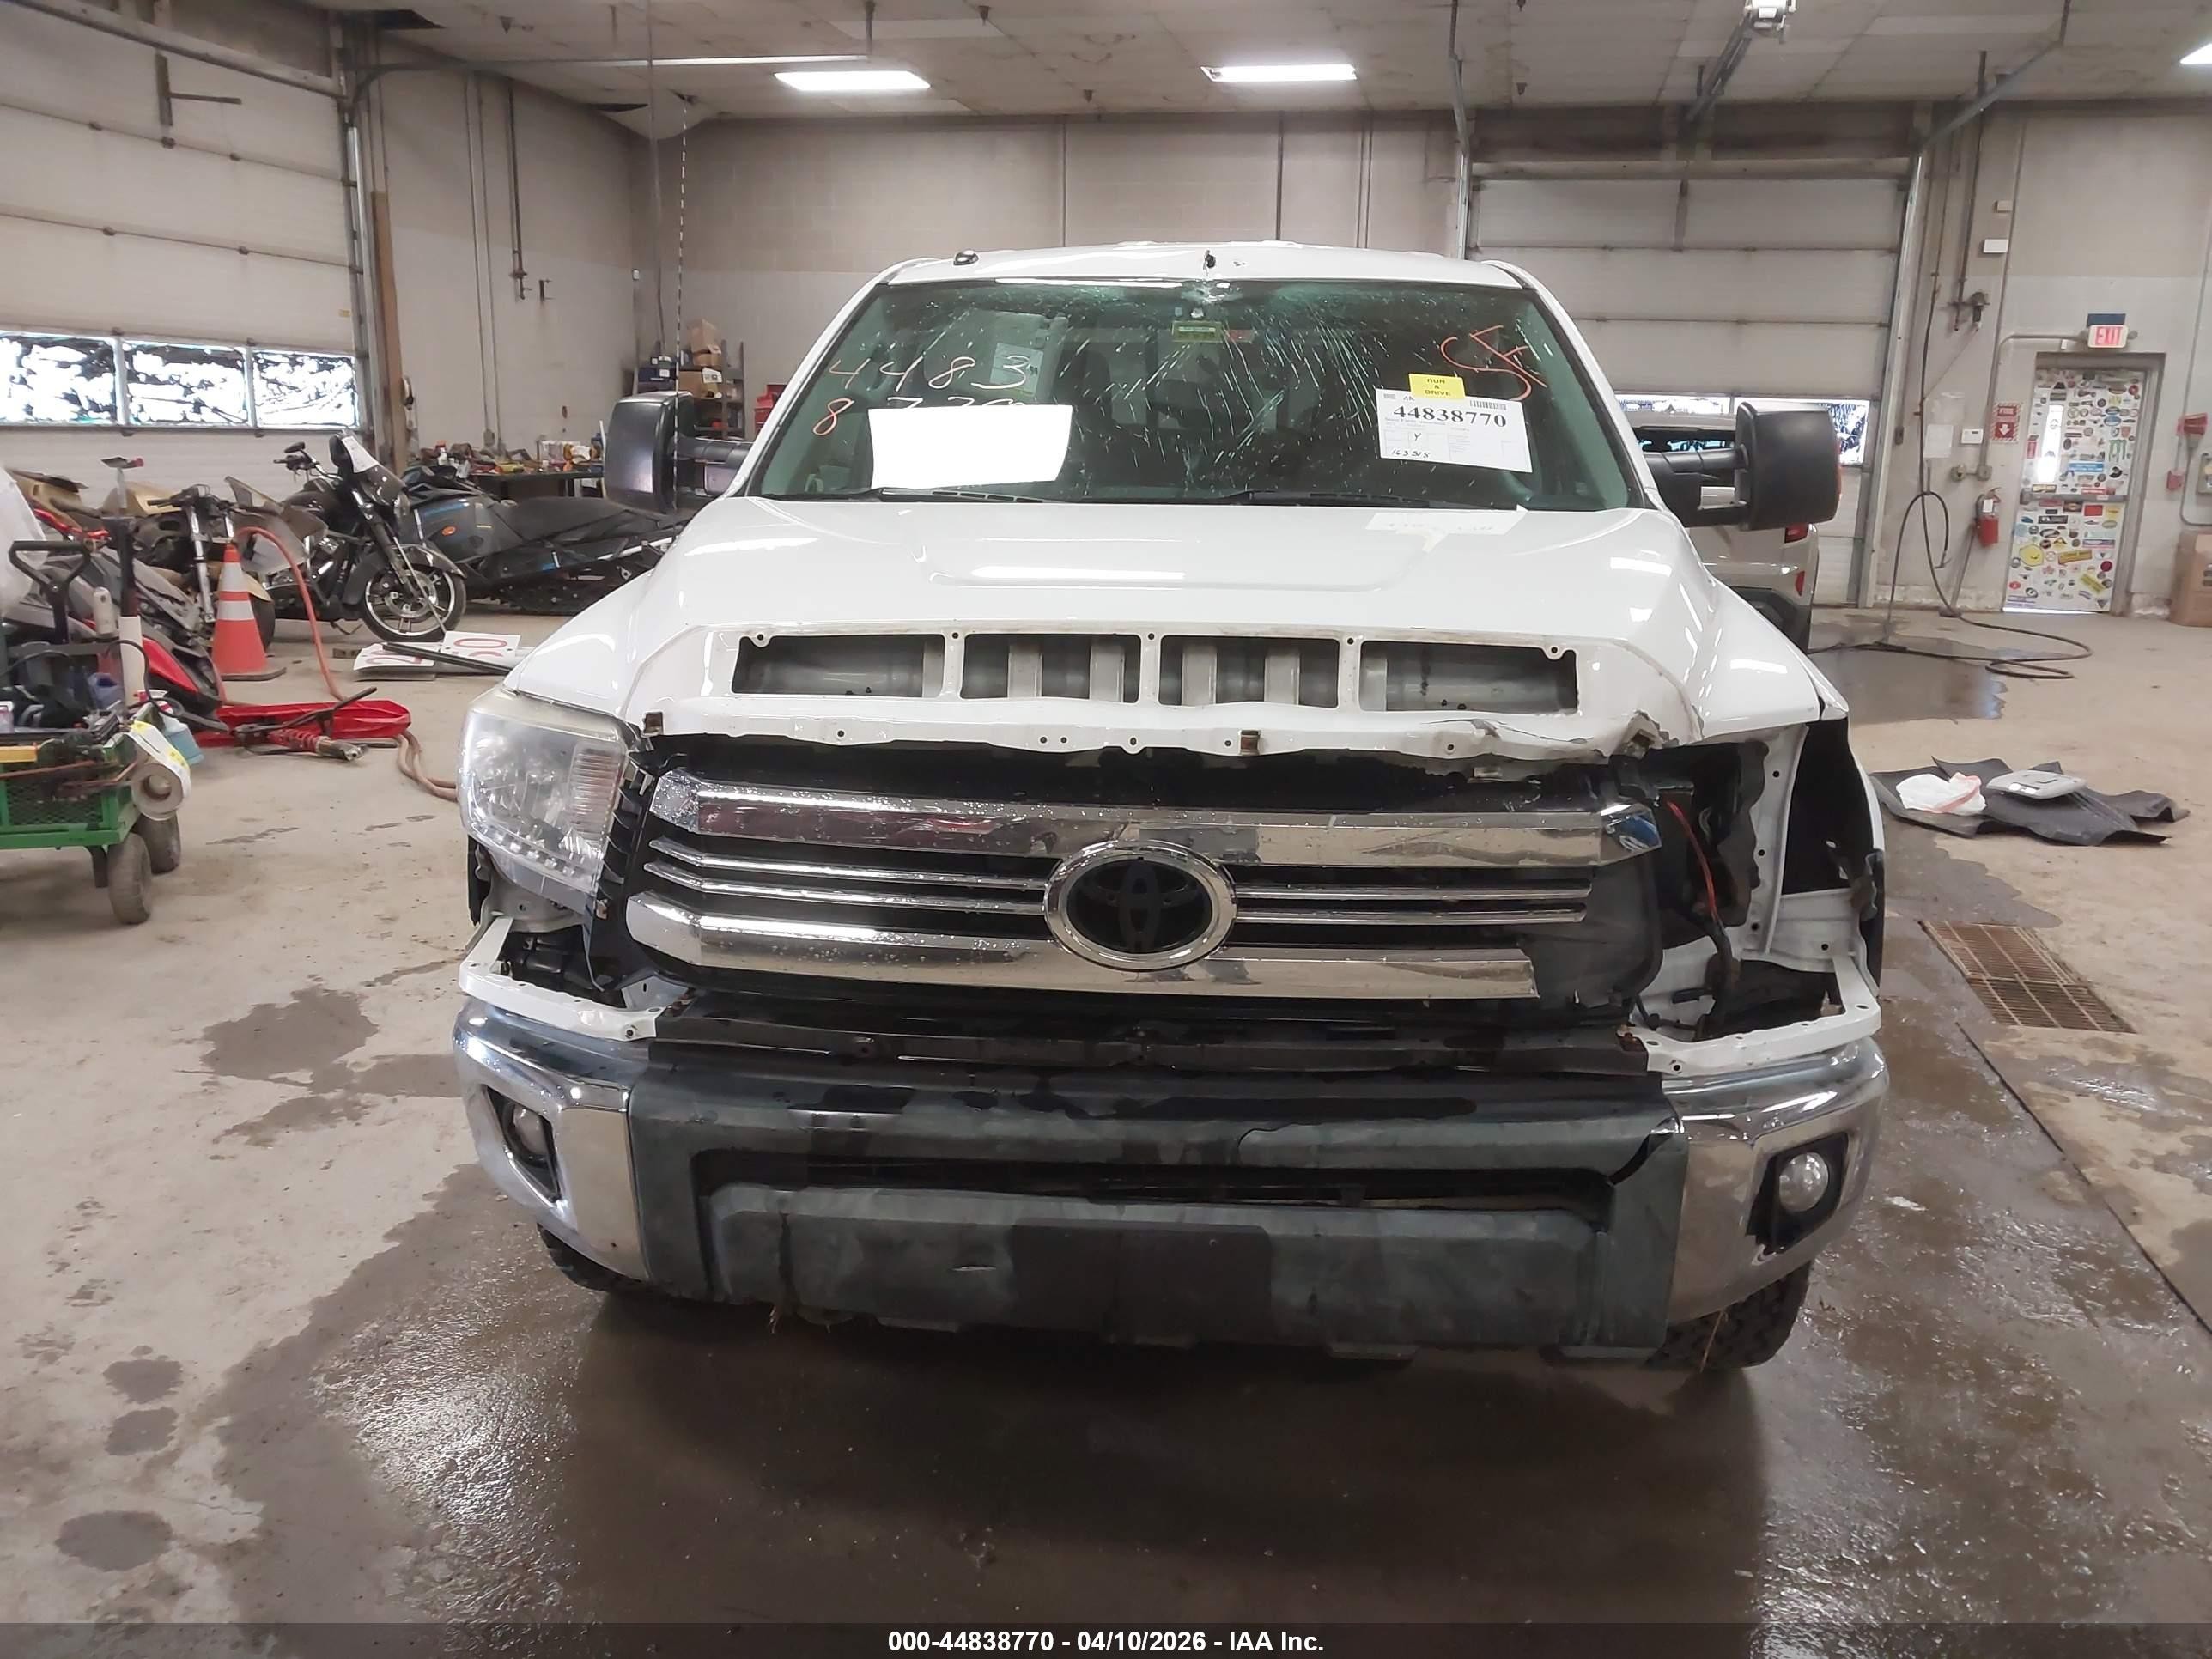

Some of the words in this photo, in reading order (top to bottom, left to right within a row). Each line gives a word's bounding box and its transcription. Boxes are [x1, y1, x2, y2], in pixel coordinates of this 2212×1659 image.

[2095, 326, 2123, 346] EXIT
[829, 355, 1029, 392] 4483
[1393, 405, 1507, 428] 44838770
